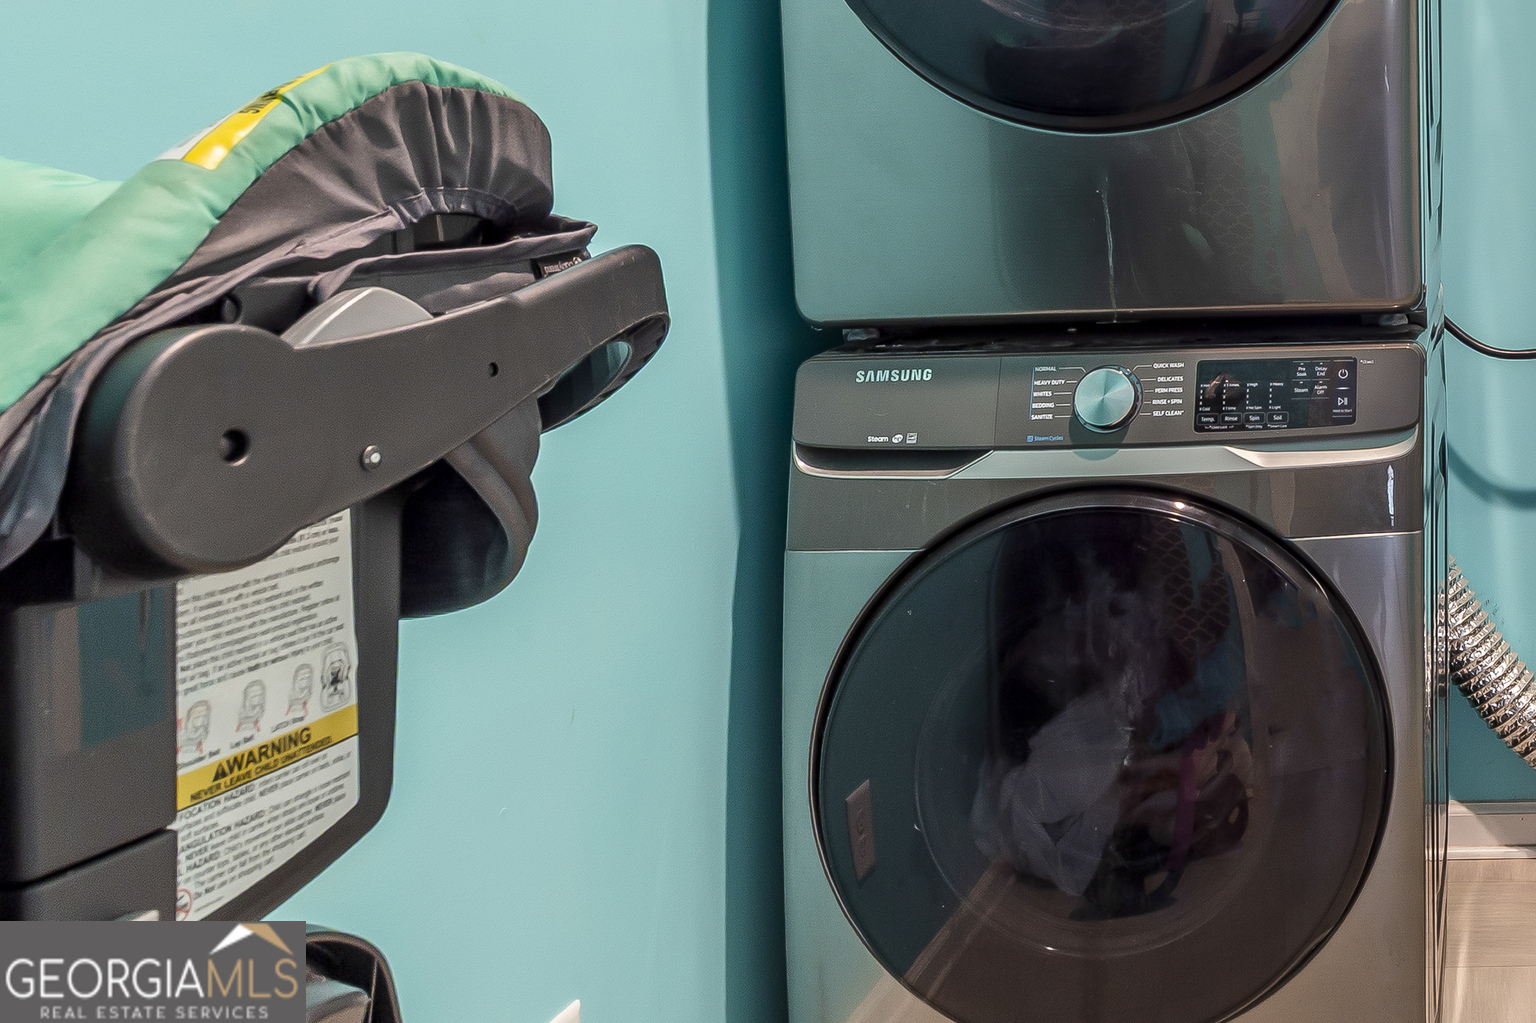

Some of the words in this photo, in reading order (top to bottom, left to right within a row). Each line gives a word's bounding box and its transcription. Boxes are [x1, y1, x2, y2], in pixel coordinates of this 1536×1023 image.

[856, 368, 932, 383] SAMSUNG
[226, 726, 312, 775] WARNING
[190, 783, 222, 802] NEVER
[224, 772, 252, 792] LEAVE
[254, 760, 280, 778] CHILD
